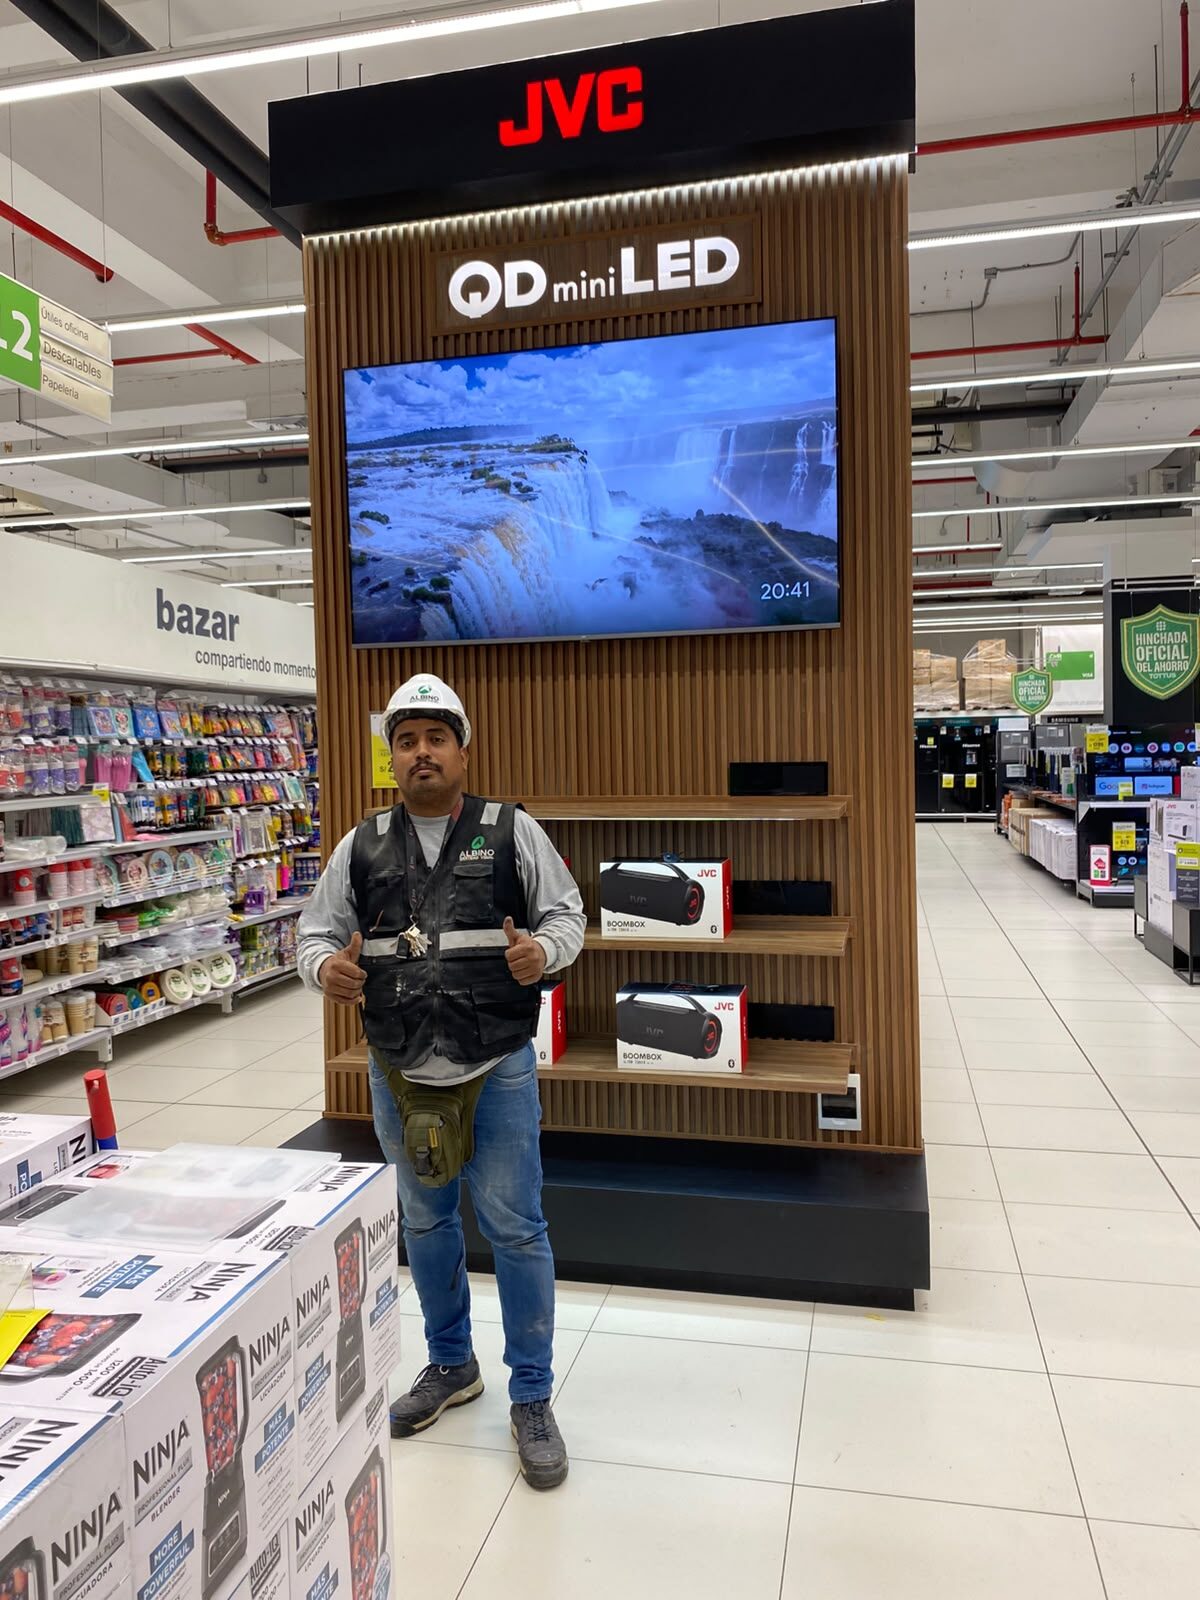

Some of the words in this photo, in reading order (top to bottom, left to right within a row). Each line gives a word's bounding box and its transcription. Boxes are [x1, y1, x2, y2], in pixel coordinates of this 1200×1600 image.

[498, 66, 644, 147] JVC
[449, 260, 546, 319] QD
[553, 267, 616, 302] mini
[620, 236, 740, 295] LED
[0, 310, 33, 361] 2
[64, 323, 89, 341] oficina
[43, 341, 102, 379] Descartables
[761, 581, 809, 599] 20:41
[156, 588, 240, 641] bazar
[1136, 631, 1188, 645] HINCHADA
[1136, 645, 1189, 661] OFICIAL
[195, 650, 271, 673] compartiendo
[1137, 662, 1152, 672] DEL
[1154, 660, 1189, 672] AHORRO
[1019, 685, 1046, 696] OFICIAL
[459, 849, 495, 859] ALBINO
[697, 869, 717, 877] JVC
[607, 920, 646, 928] BOOMBOX
[714, 1002, 734, 1011] JVC
[623, 1052, 662, 1060] BOOMBOX
[318, 1166, 370, 1192] NINJA
[368, 1209, 396, 1254] NINJA
[92, 1260, 144, 1293] POTENTE
[183, 1263, 257, 1302] NINJA
[296, 1274, 330, 1328] NINJA
[249, 1316, 290, 1378] NINJA
[73, 1369, 97, 1385] 1400
[100, 1360, 124, 1375] 1200
[307, 1358, 323, 1381] MORE
[300, 1368, 329, 1407] POWERFUL
[133, 1419, 191, 1501] NINJA
[261, 1423, 289, 1461] POTENTE
[137, 1472, 177, 1516] PROFESSIONAL
[151, 1486, 181, 1522] BLENDER
[295, 1479, 334, 1550] NINJA
[51, 1491, 122, 1585] NINJA
[153, 1530, 179, 1566] MORE
[59, 1551, 102, 1600] PROFESIONAL
[104, 1534, 119, 1553] PLUS
[75, 1562, 113, 1600] CUADORA
[143, 1542, 190, 1600] POWERFUL
